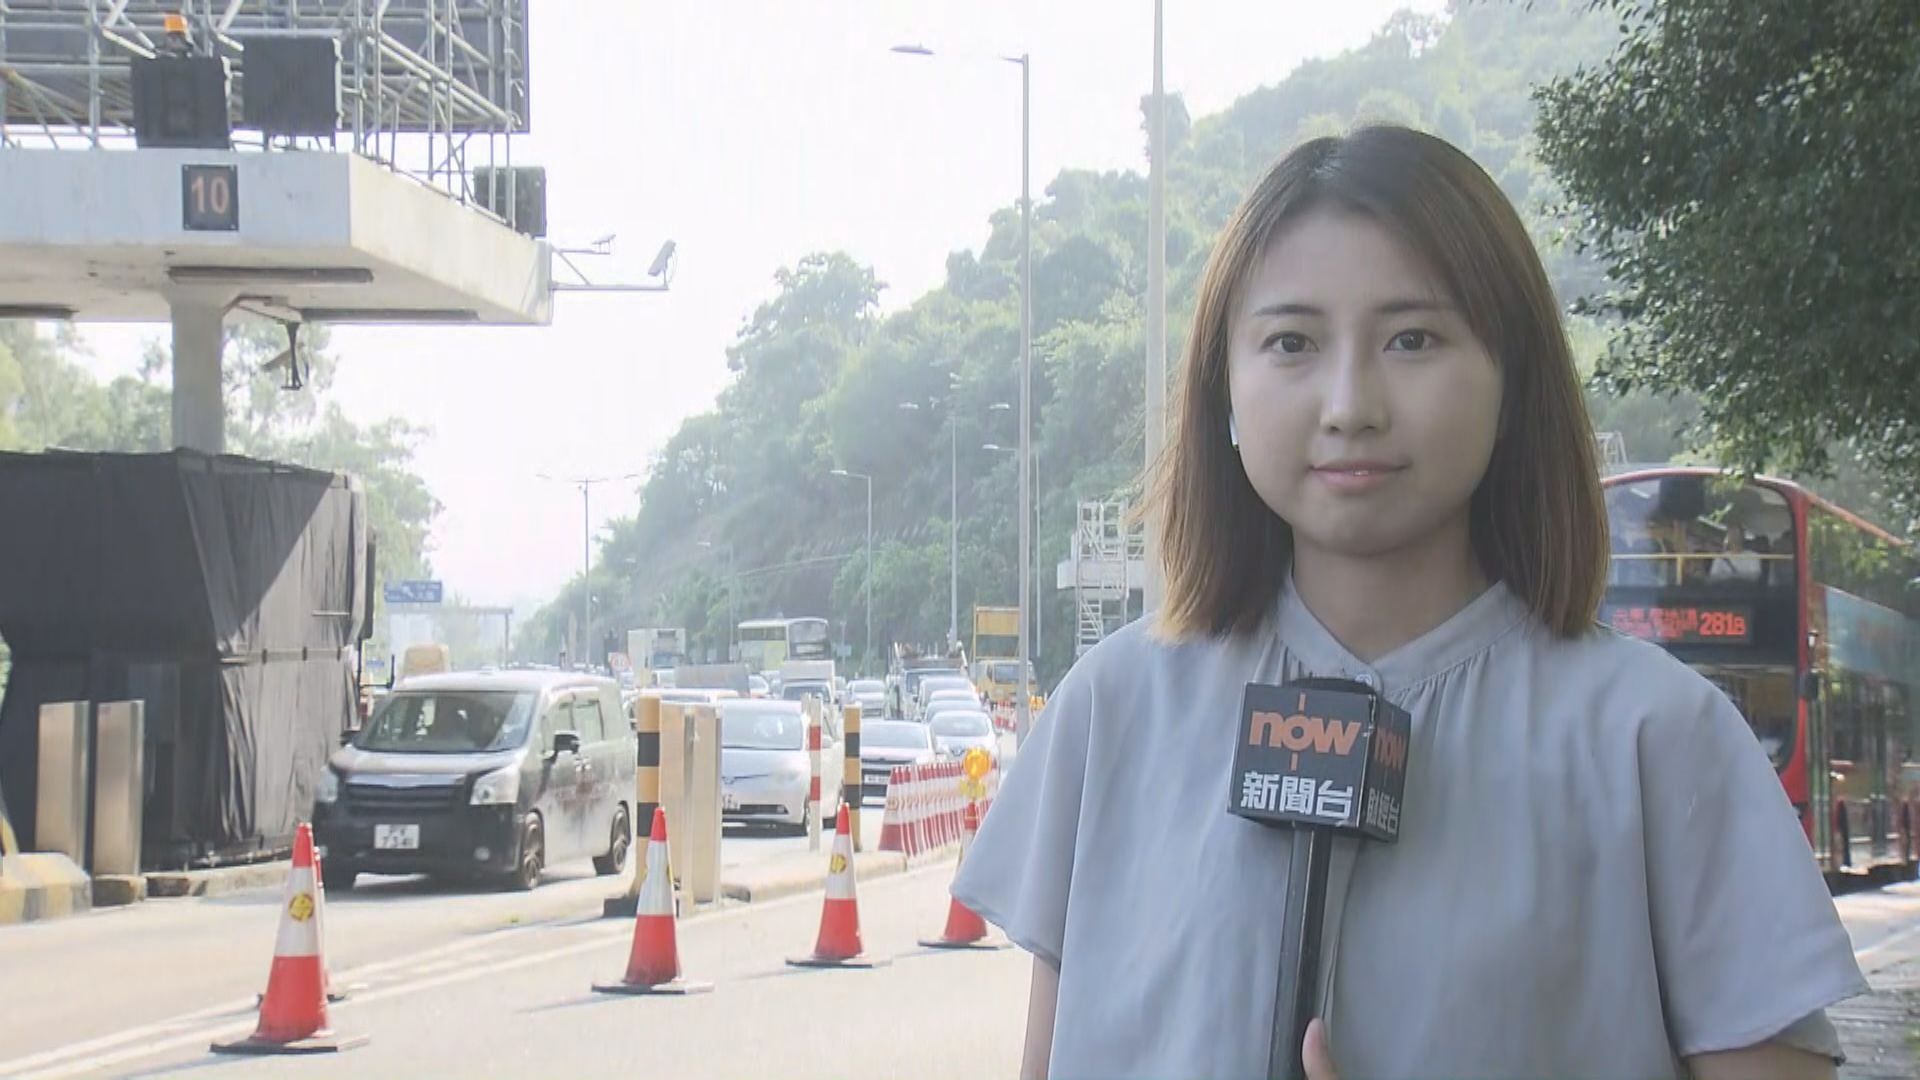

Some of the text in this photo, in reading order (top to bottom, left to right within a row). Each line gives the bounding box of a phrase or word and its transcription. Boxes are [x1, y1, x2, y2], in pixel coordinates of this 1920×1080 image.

[192, 176, 229, 213] 10
[1248, 709, 1362, 758] now
[1375, 727, 1405, 771] now
[1240, 771, 1353, 819] 新聞台
